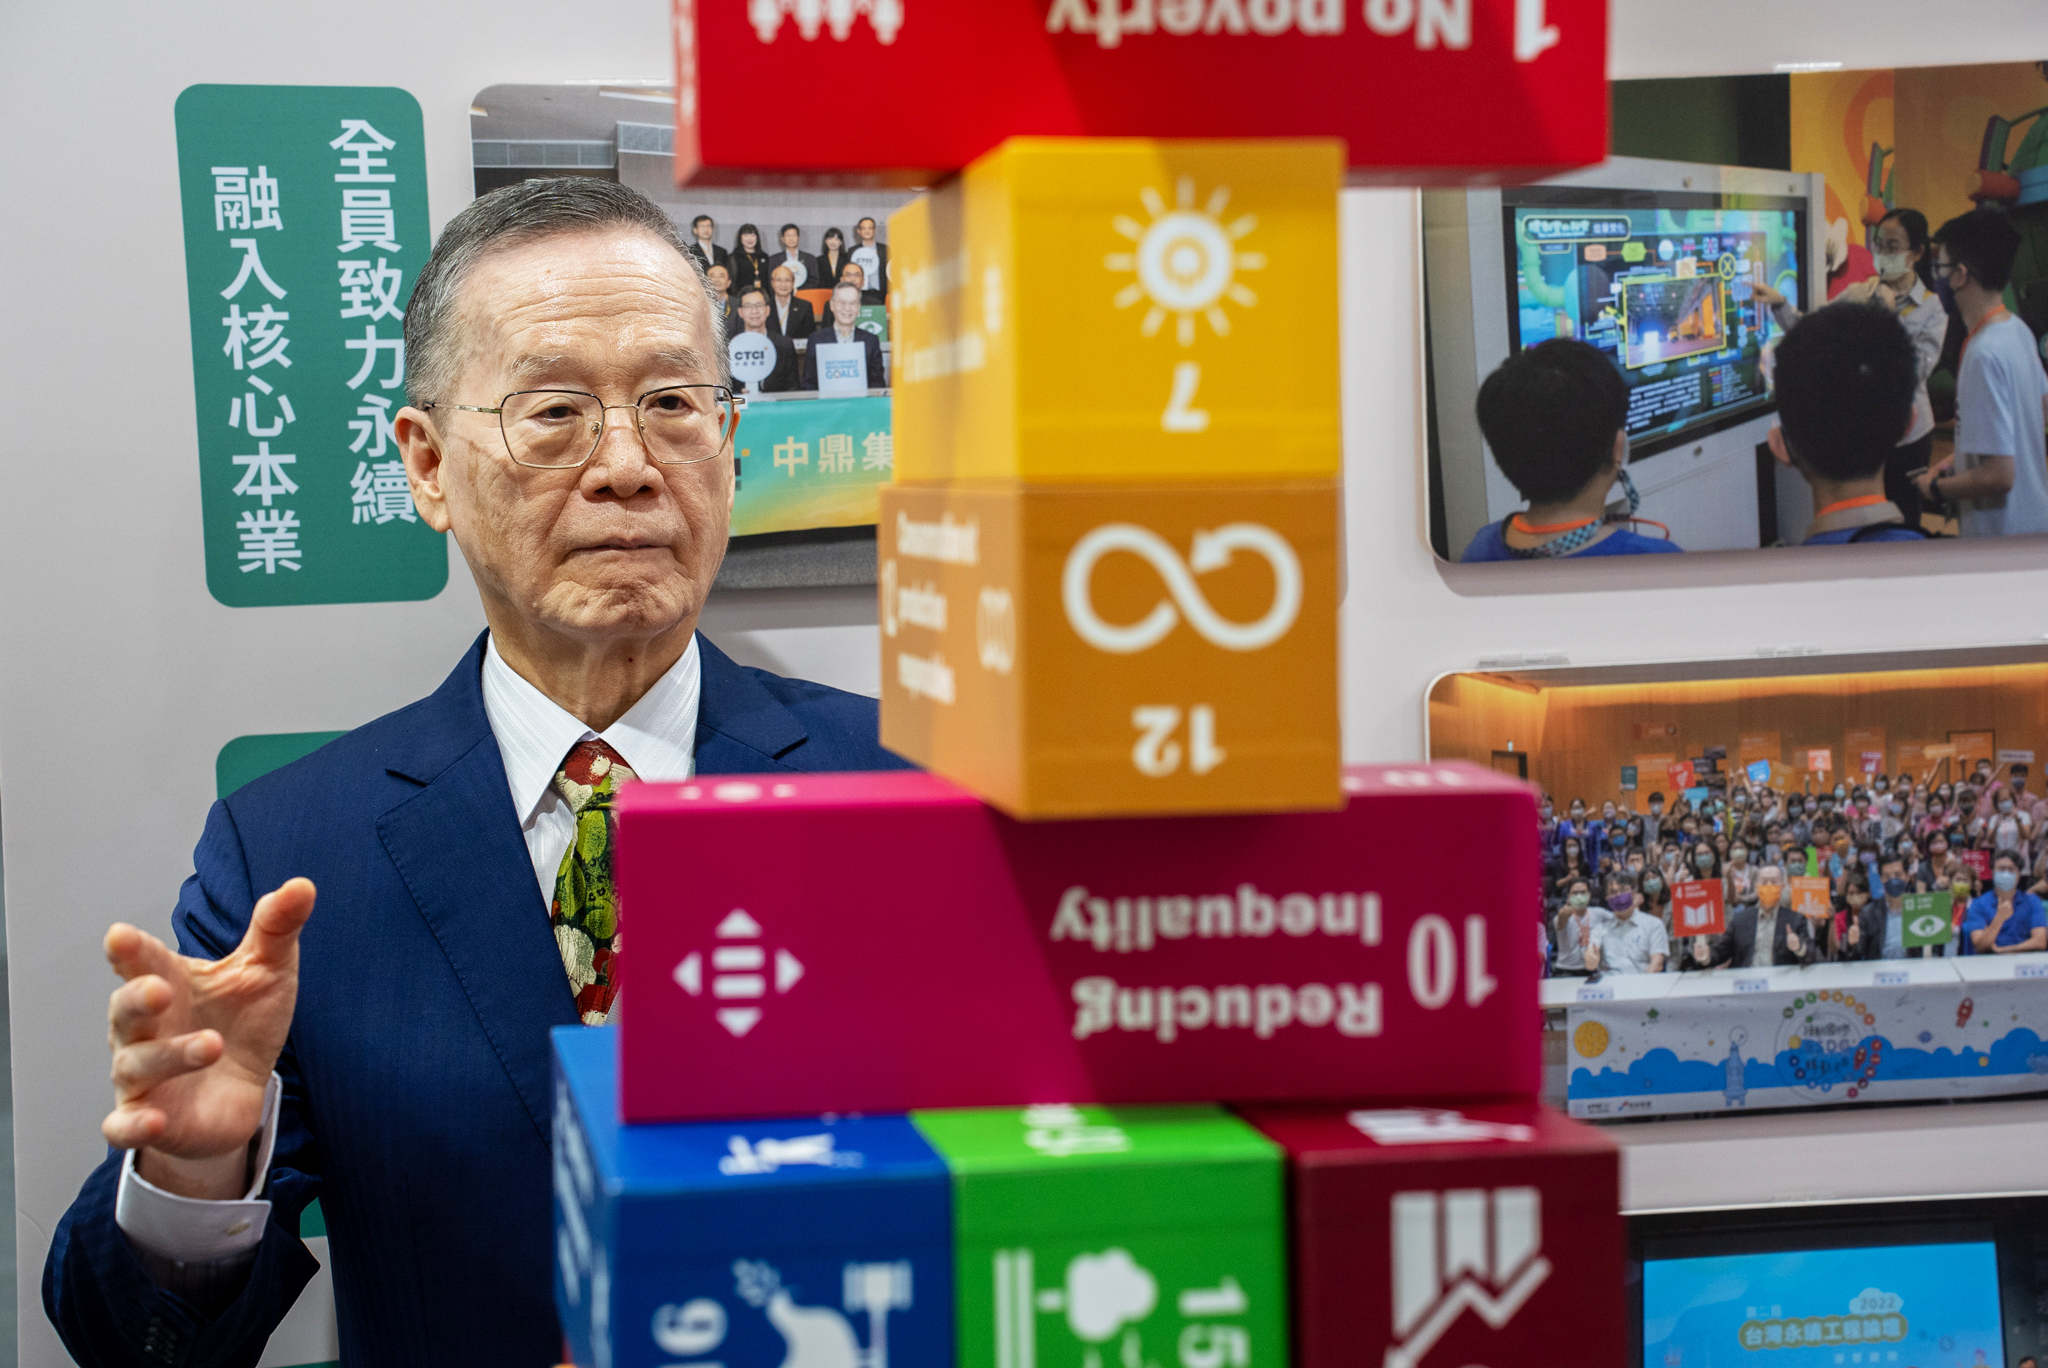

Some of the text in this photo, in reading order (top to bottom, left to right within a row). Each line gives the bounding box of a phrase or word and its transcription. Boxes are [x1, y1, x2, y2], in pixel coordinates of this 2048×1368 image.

[1044, 0, 1473, 51] No poverty
[329, 118, 418, 525] 全員致力永續
[734, 350, 764, 361] CTCI
[211, 165, 303, 575] 融入核心本業
[825, 369, 860, 380] GOALS
[1161, 361, 1210, 432] 7
[773, 431, 894, 477] 中鼎集
[1131, 704, 1226, 777] 12
[1049, 882, 1384, 954] Inequality
[1405, 912, 1499, 1011] 10
[1071, 974, 1384, 1044] Reducing
[1860, 1296, 1896, 1310] 2022
